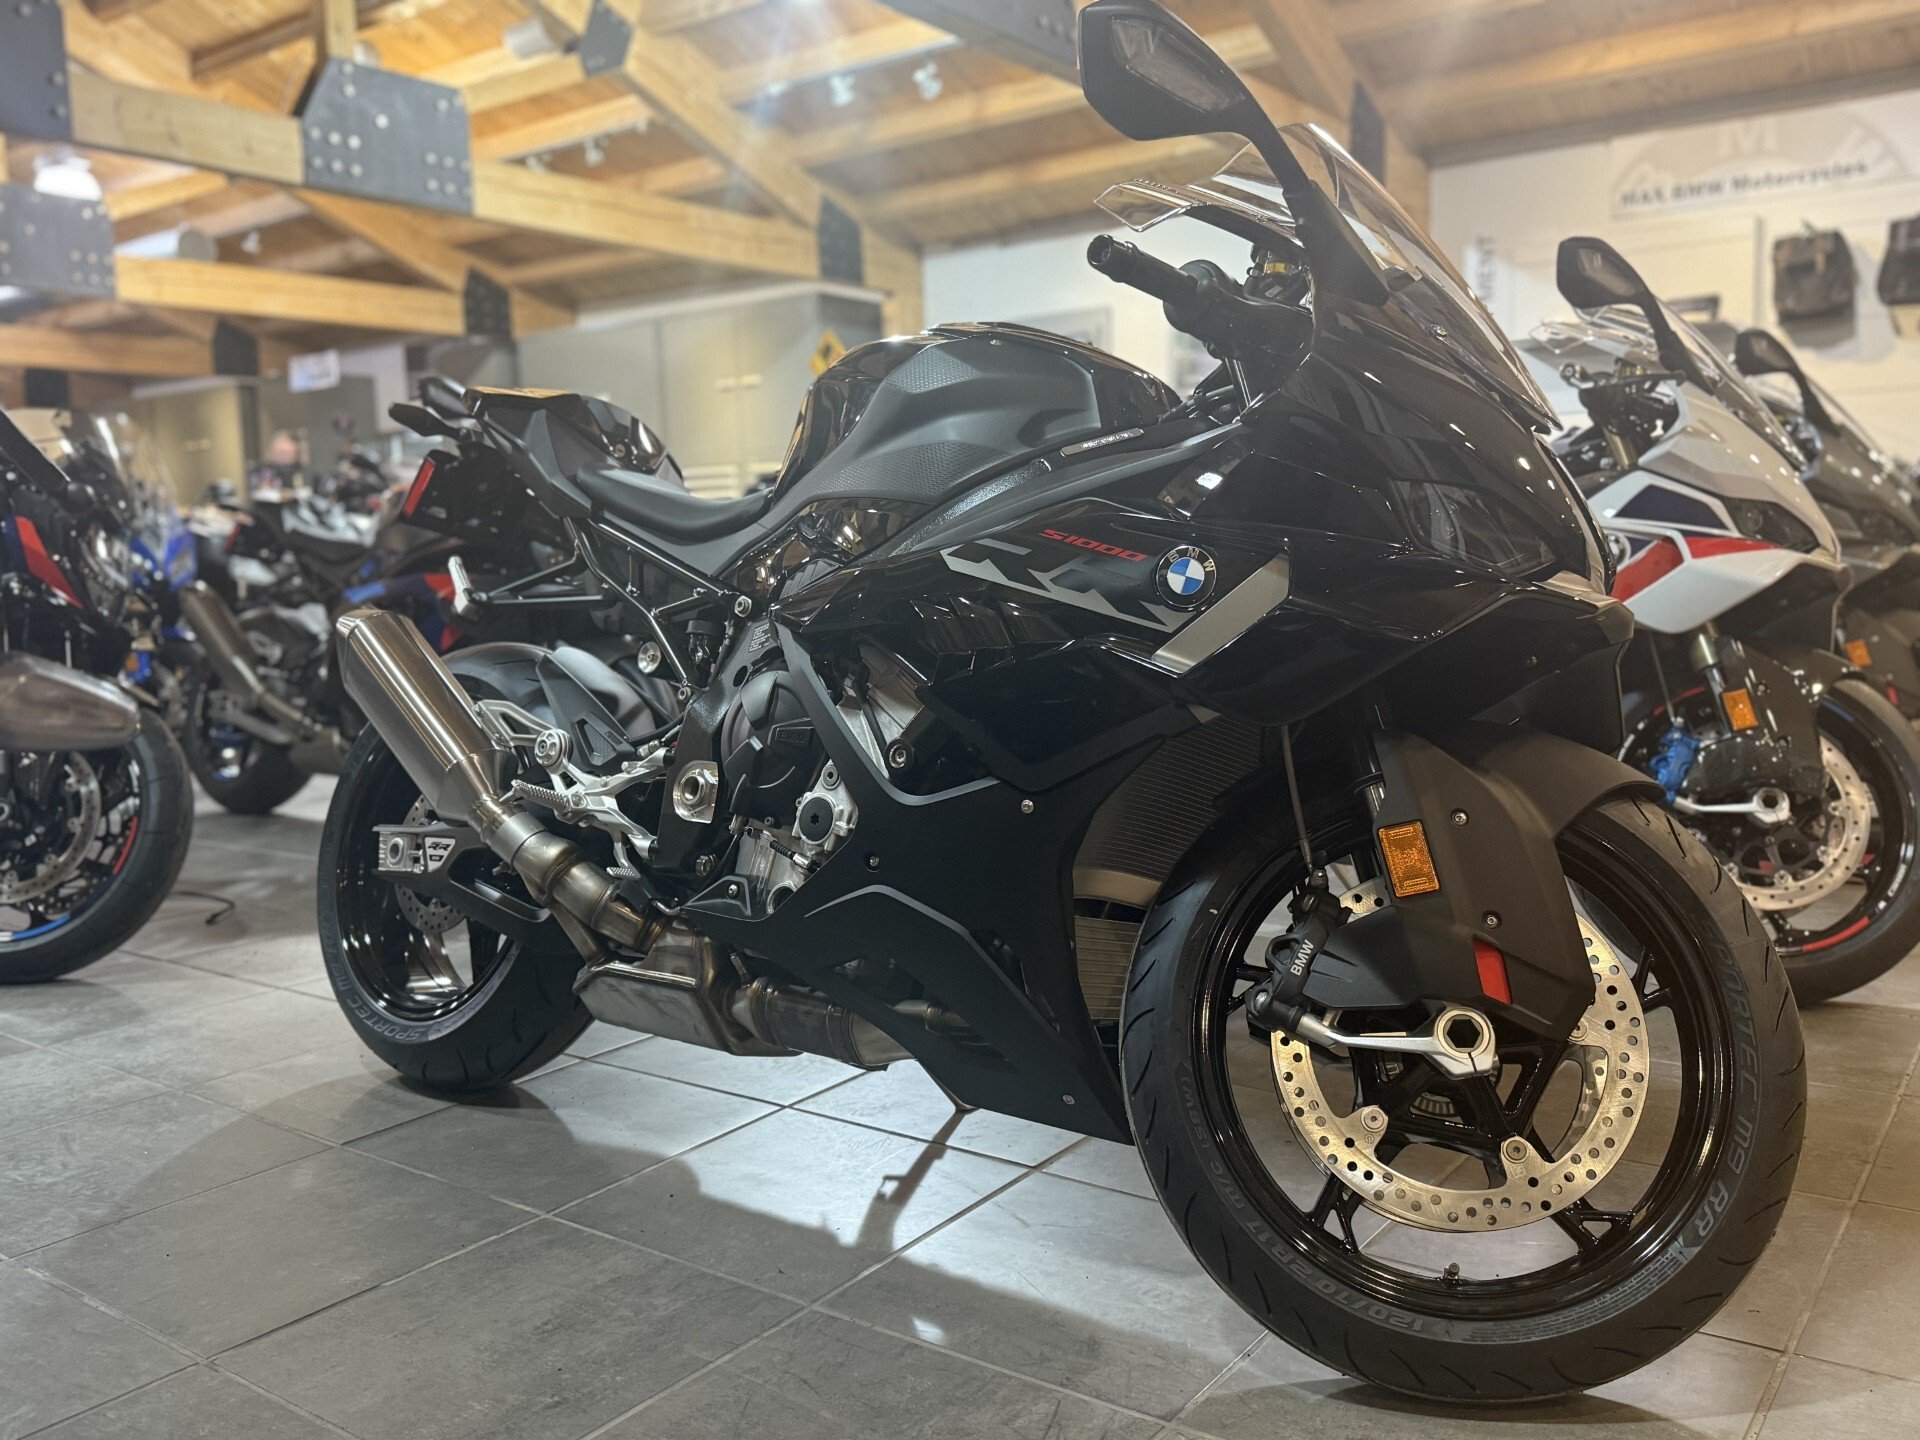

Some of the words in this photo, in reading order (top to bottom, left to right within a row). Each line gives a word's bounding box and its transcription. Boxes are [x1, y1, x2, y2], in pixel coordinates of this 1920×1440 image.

[1670, 178, 1725, 200] BMW
[1729, 159, 1871, 191] Motorcycles
[1039, 528, 1149, 562] S1000
[1290, 939, 1314, 976] BMW
[346, 995, 427, 1041] SPORTEC
[1694, 1179, 1729, 1238] RR
[1316, 1279, 1424, 1332] 120/70
